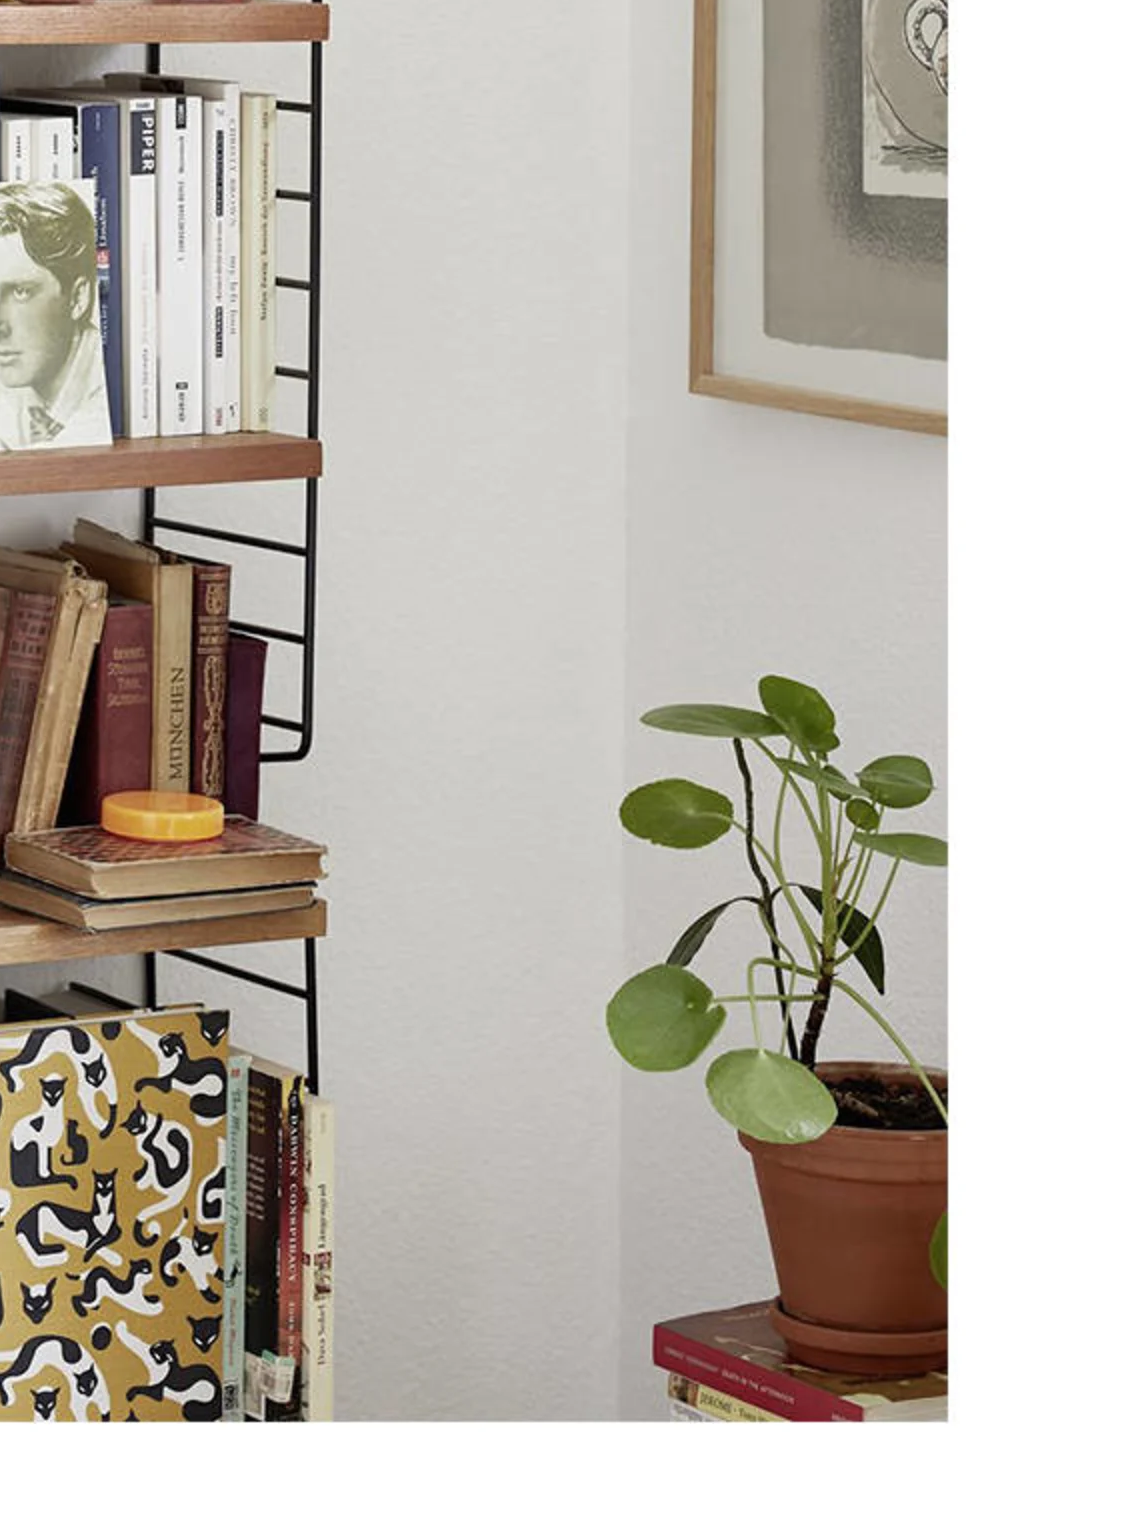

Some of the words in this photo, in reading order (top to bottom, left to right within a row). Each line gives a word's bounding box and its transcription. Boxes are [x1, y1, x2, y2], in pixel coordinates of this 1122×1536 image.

[141, 116, 155, 172] PIPER
[289, 1114, 299, 1177] DARWIN
[288, 1182, 298, 1282] CONSPIRACY
